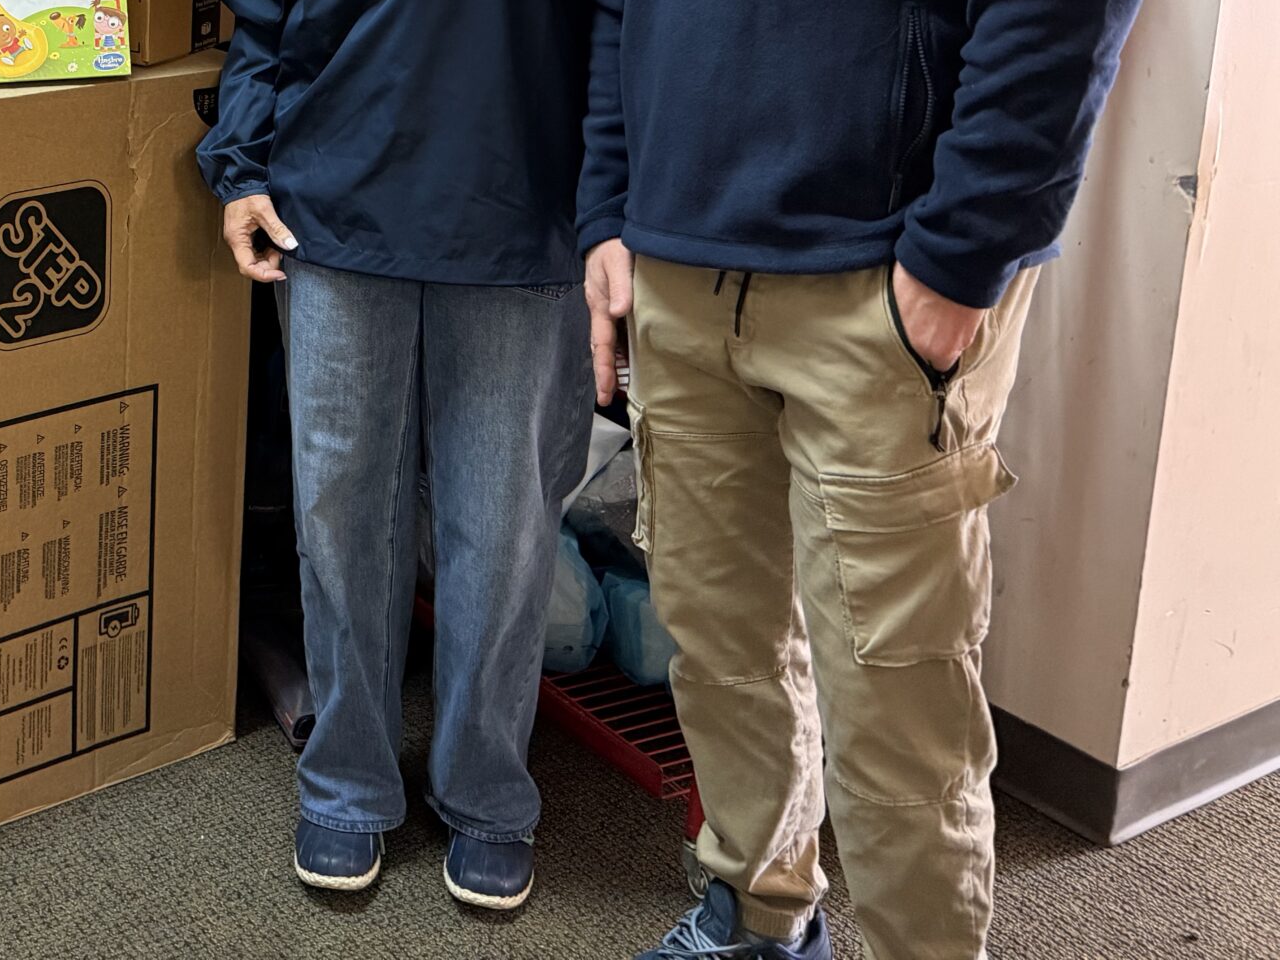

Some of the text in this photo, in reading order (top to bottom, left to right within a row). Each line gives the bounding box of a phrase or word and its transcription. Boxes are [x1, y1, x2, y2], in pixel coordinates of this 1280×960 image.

[74, 441, 83, 492] ADVERTENCIA:
[118, 424, 130, 477] WARNING:
[116, 506, 128, 583] MISE EN GARDE:
